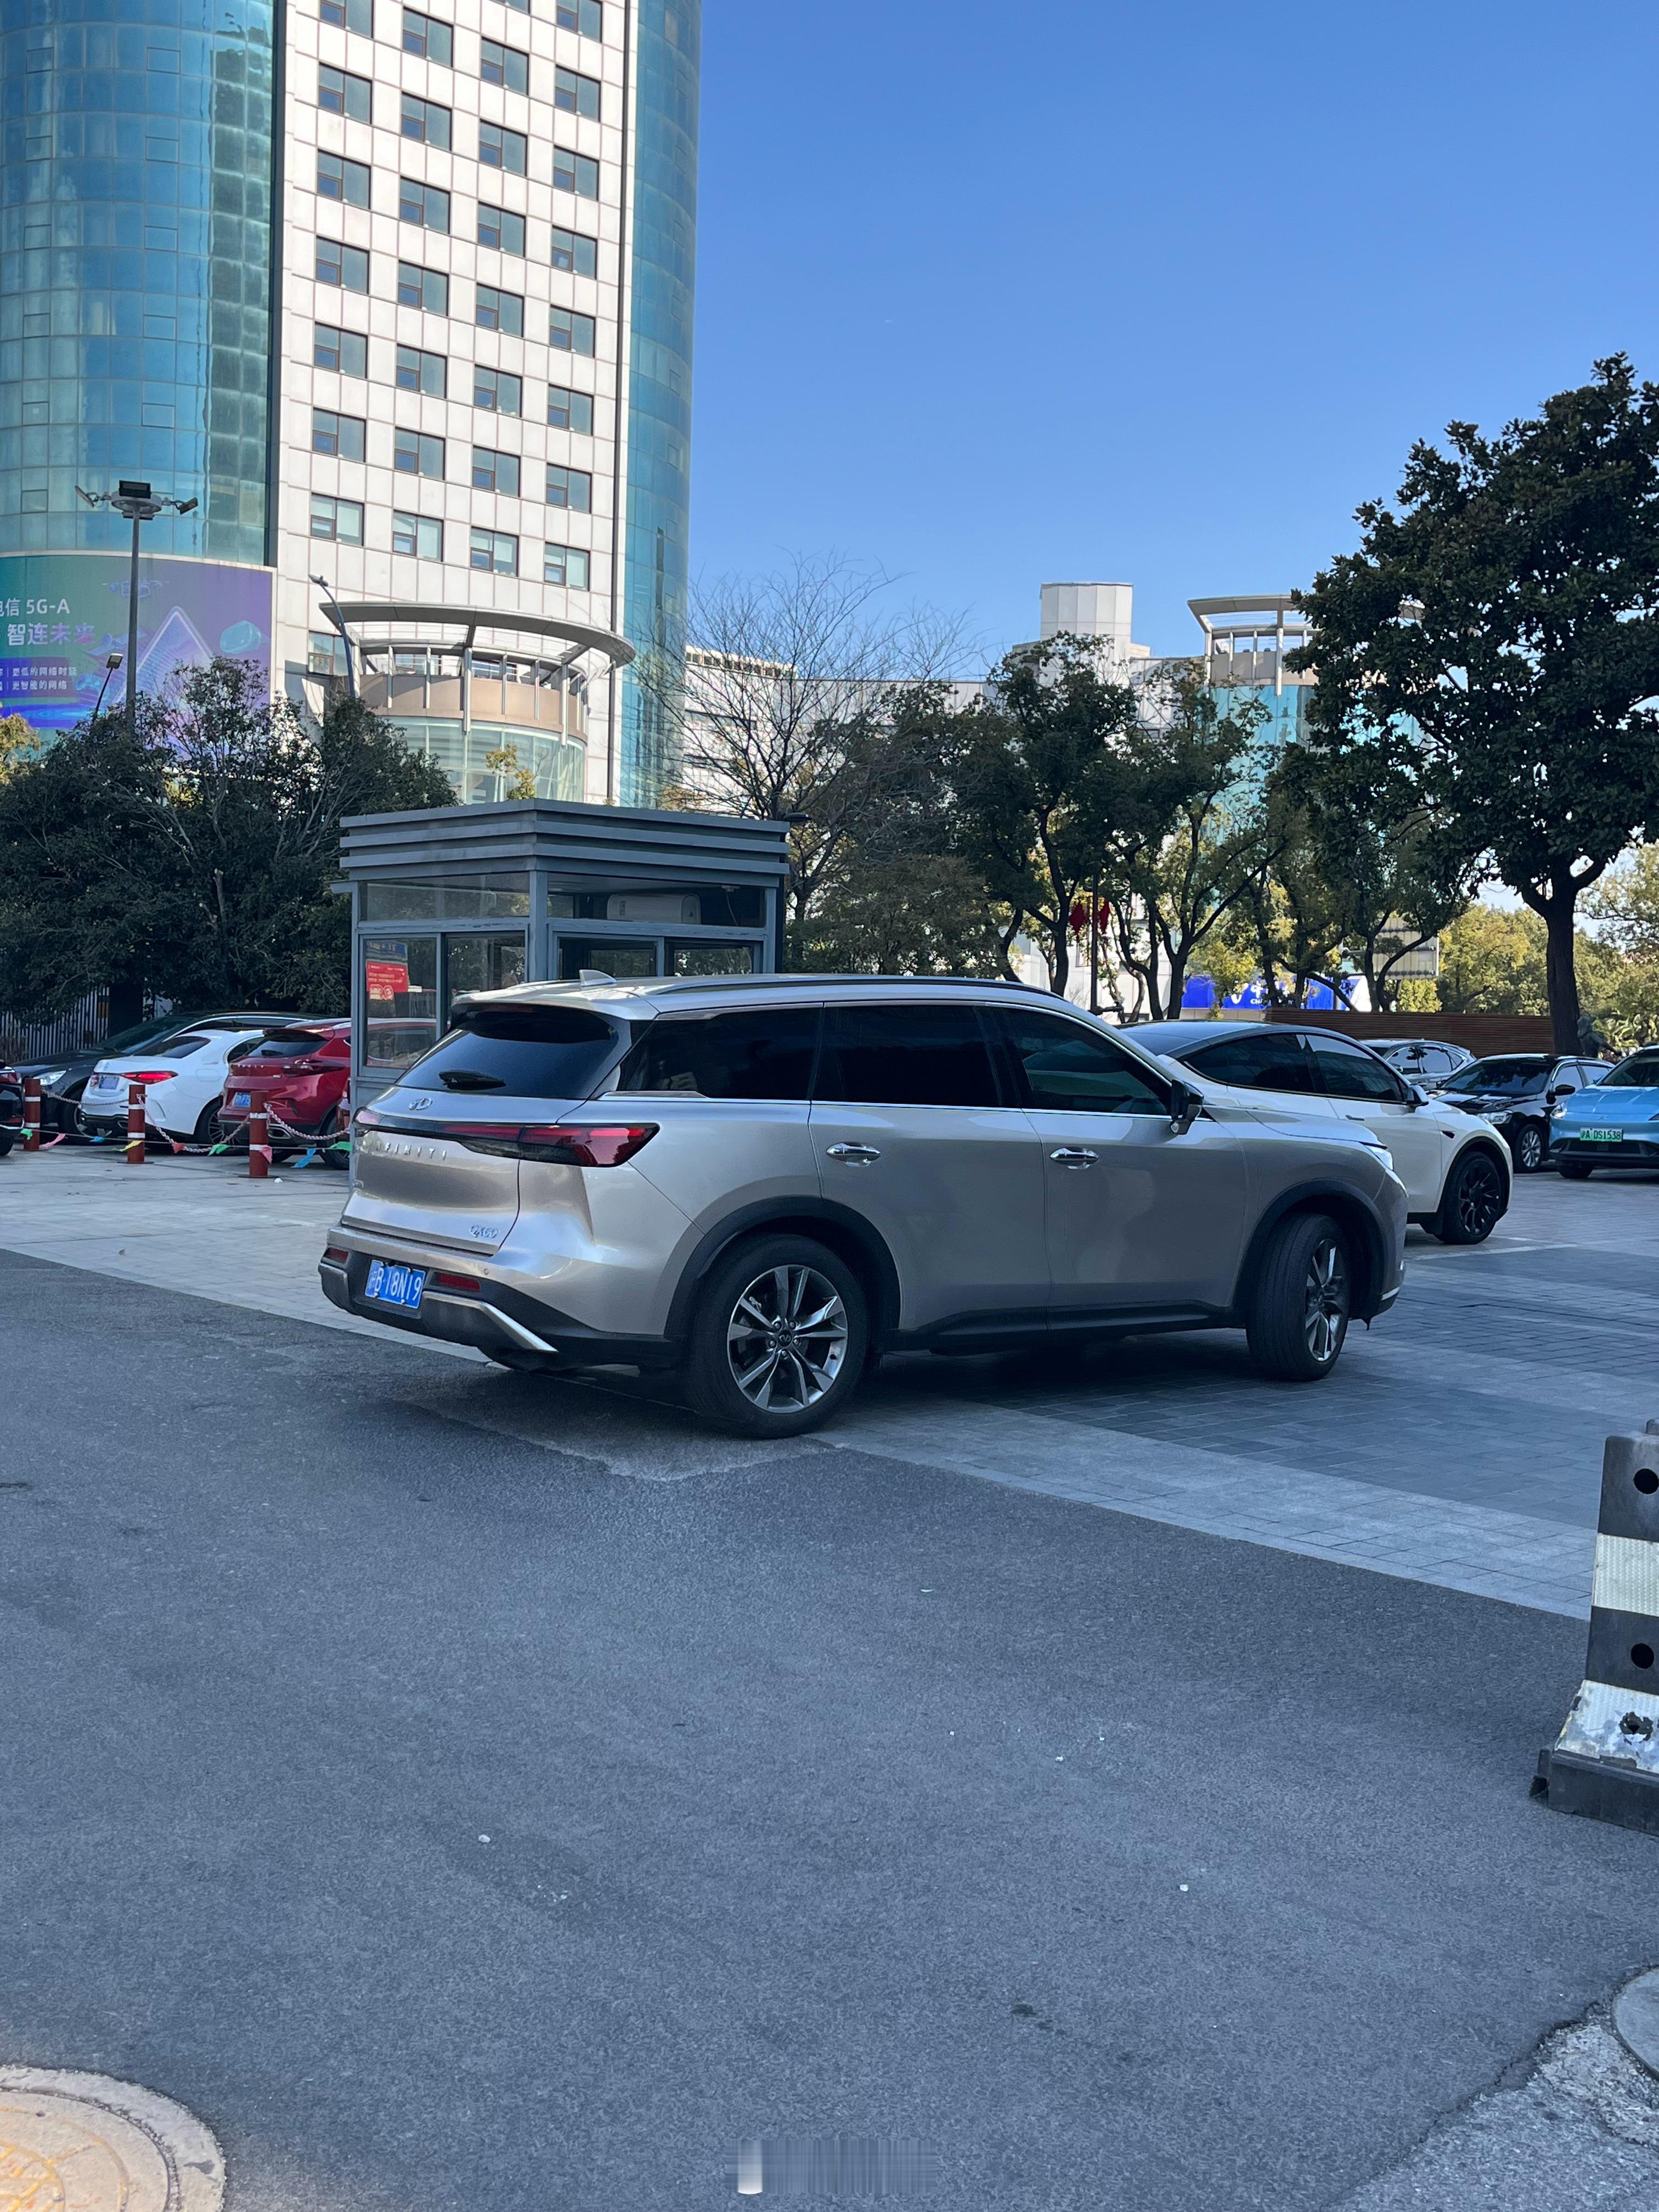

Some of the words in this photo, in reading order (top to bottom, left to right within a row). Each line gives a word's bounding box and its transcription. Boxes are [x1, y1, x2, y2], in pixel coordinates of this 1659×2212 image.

[26, 598, 71, 614] 5G-A
[7, 622, 96, 647] 智连未来
[12, 666, 77, 677] 更低的网络时延
[12, 680, 67, 691] 更智能的网络
[368, 1138, 448, 1161] NFINITI
